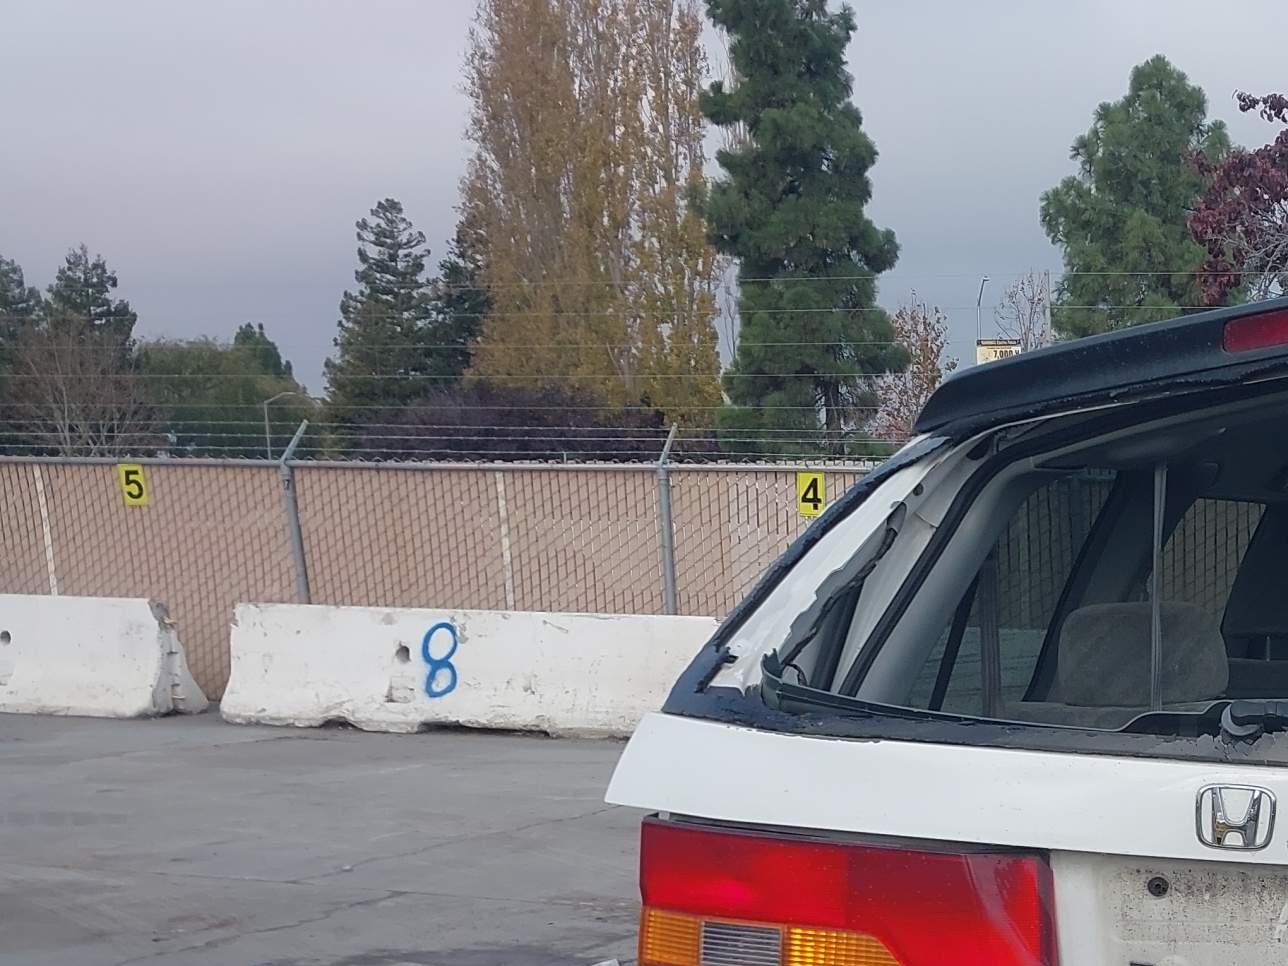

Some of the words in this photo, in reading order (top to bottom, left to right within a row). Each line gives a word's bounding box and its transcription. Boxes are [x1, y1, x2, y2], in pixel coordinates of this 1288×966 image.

[125, 470, 143, 499] 5
[801, 477, 822, 510] 4
[422, 622, 457, 698] 8
